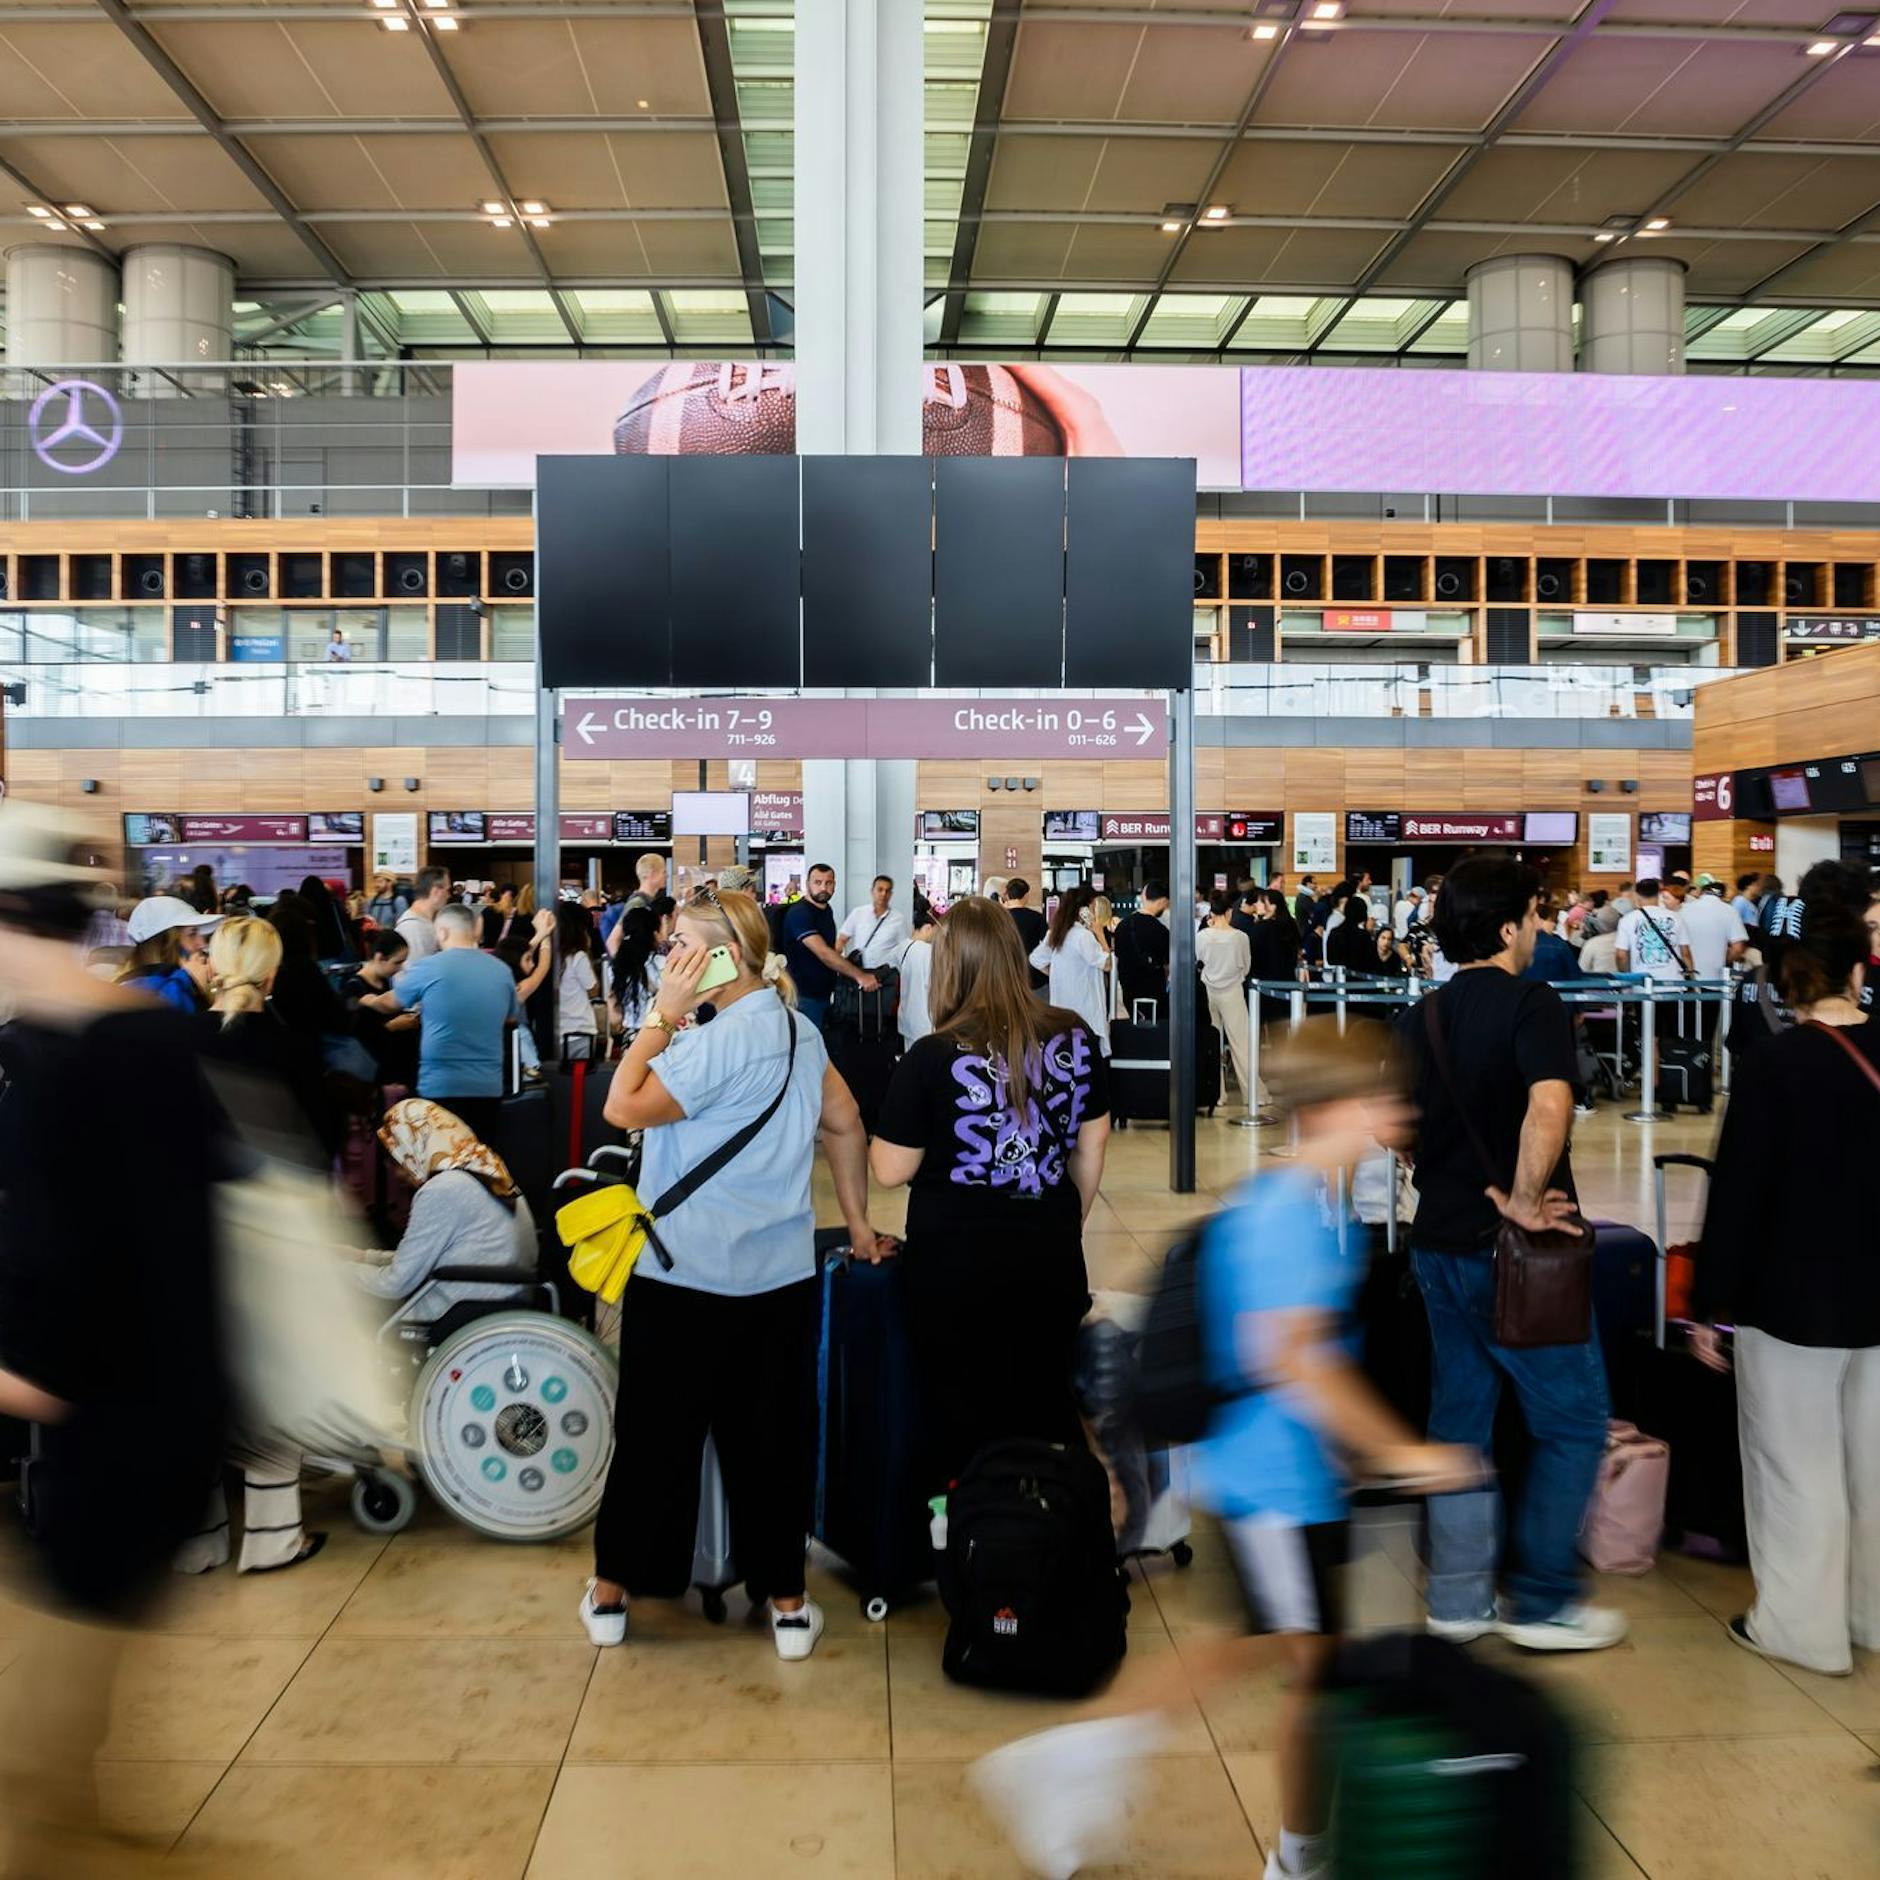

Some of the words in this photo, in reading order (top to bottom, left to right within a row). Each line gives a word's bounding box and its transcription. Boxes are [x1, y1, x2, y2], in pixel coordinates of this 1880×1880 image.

[614, 708, 720, 730] Check-in
[954, 708, 1059, 730] Check-in
[737, 763, 755, 786] 4
[753, 793, 790, 807] Abflug
[1717, 776, 1731, 810] 6
[1120, 822, 1142, 834] BER
[1419, 823, 1441, 835] BER
[1442, 823, 1489, 837] Runway
